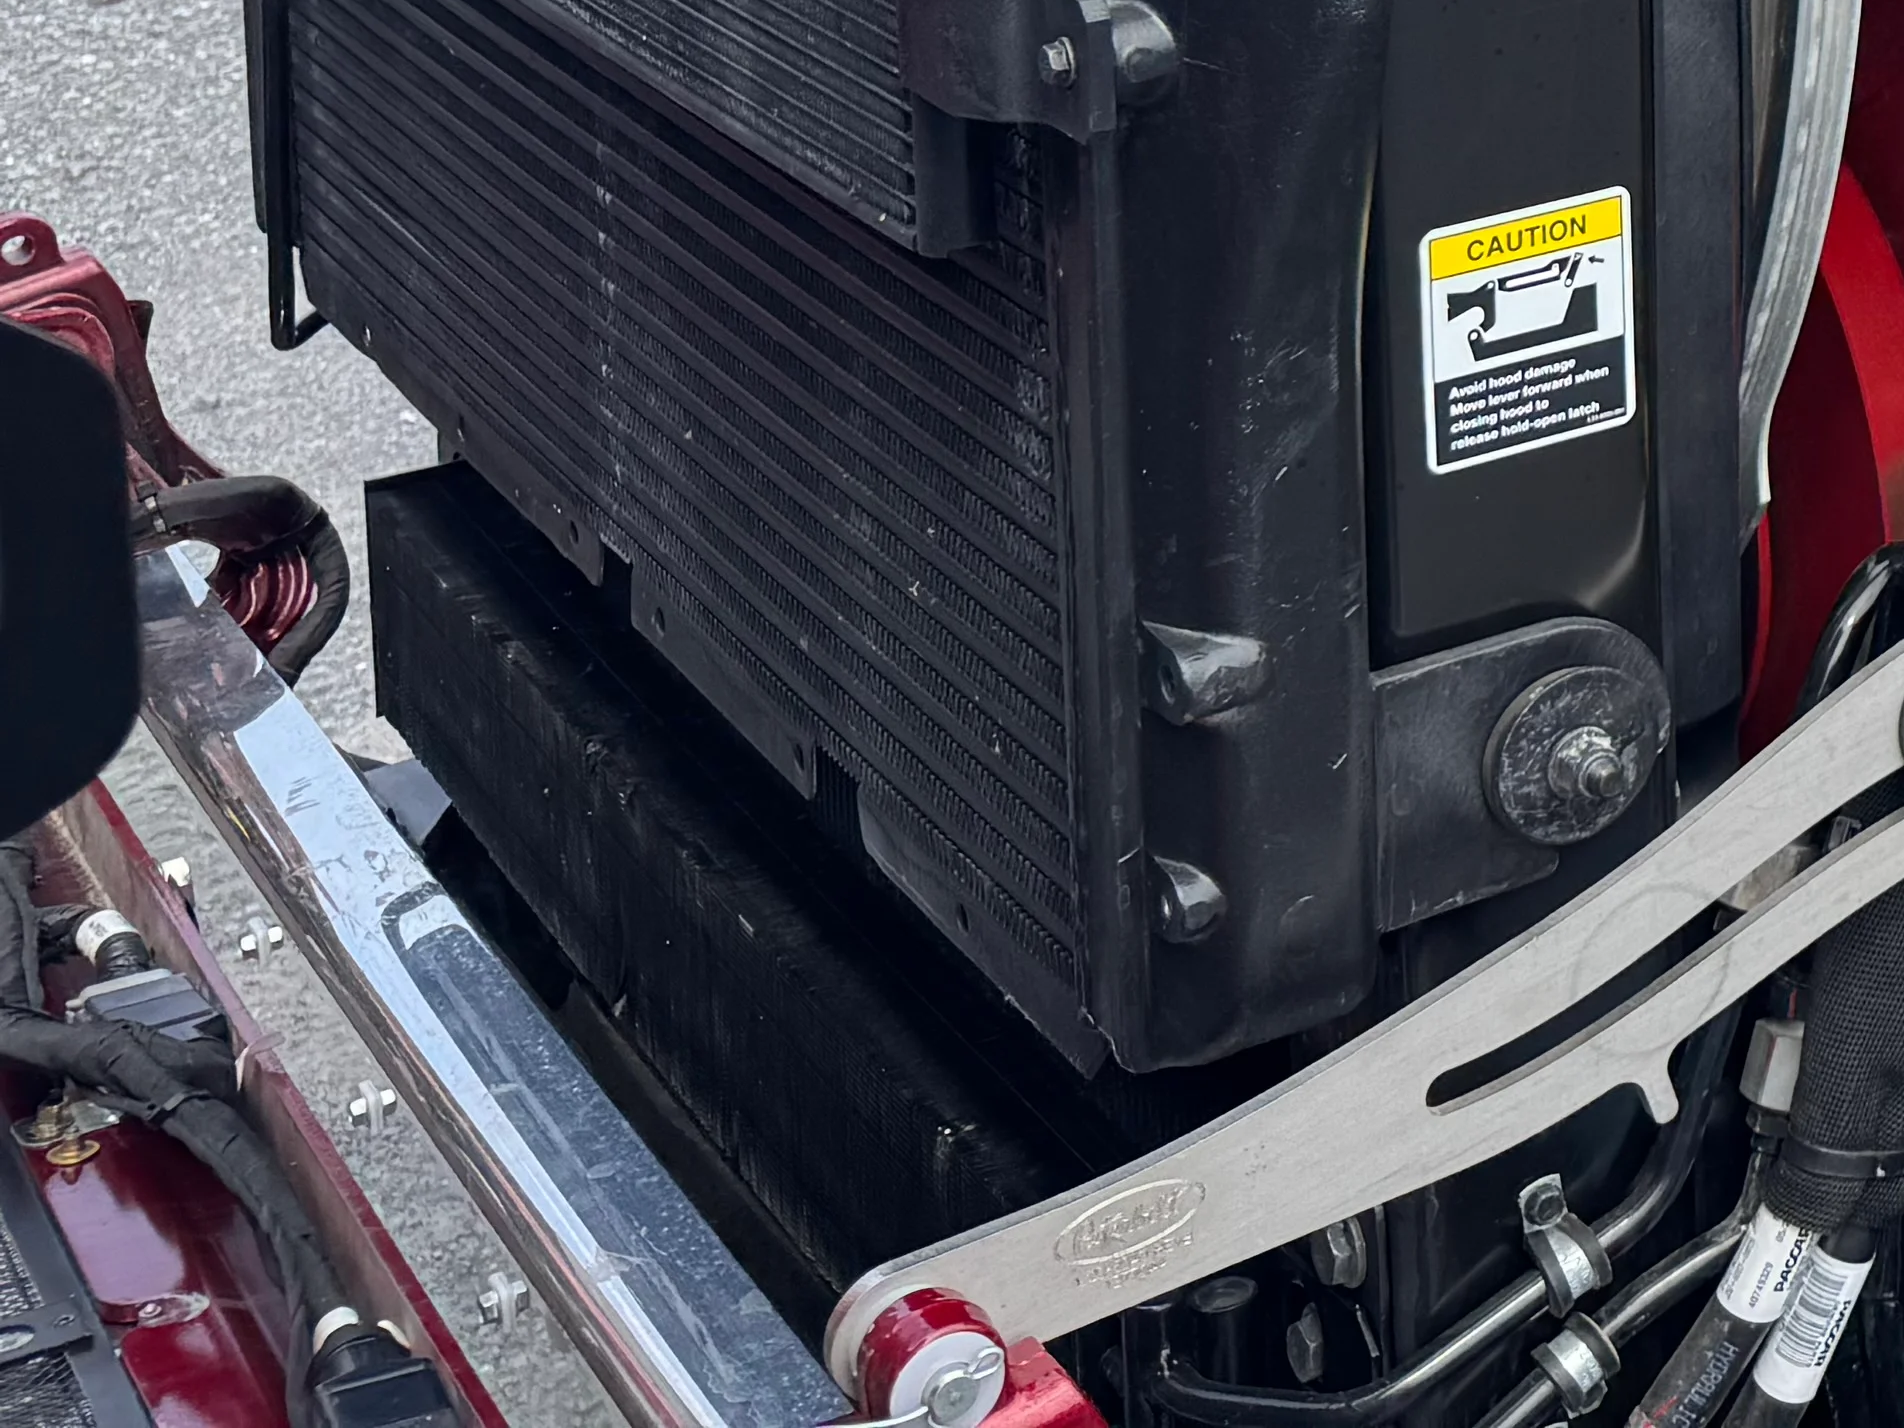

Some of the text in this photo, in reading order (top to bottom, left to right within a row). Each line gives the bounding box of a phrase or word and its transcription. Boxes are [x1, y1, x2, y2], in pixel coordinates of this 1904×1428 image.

[1467, 214, 1587, 262] CAUTION
[1448, 358, 1577, 400] Avoid hood damage
[1450, 365, 1610, 417] Move lever forward when
[1450, 398, 1550, 435] closing hood to
[1450, 430, 1499, 452] release
[1501, 410, 1567, 437] hold-open
[1568, 400, 1601, 420] latch
[1773, 1227, 1812, 1293] PACCAR
[1672, 1340, 1741, 1428] HYDRAULIC
